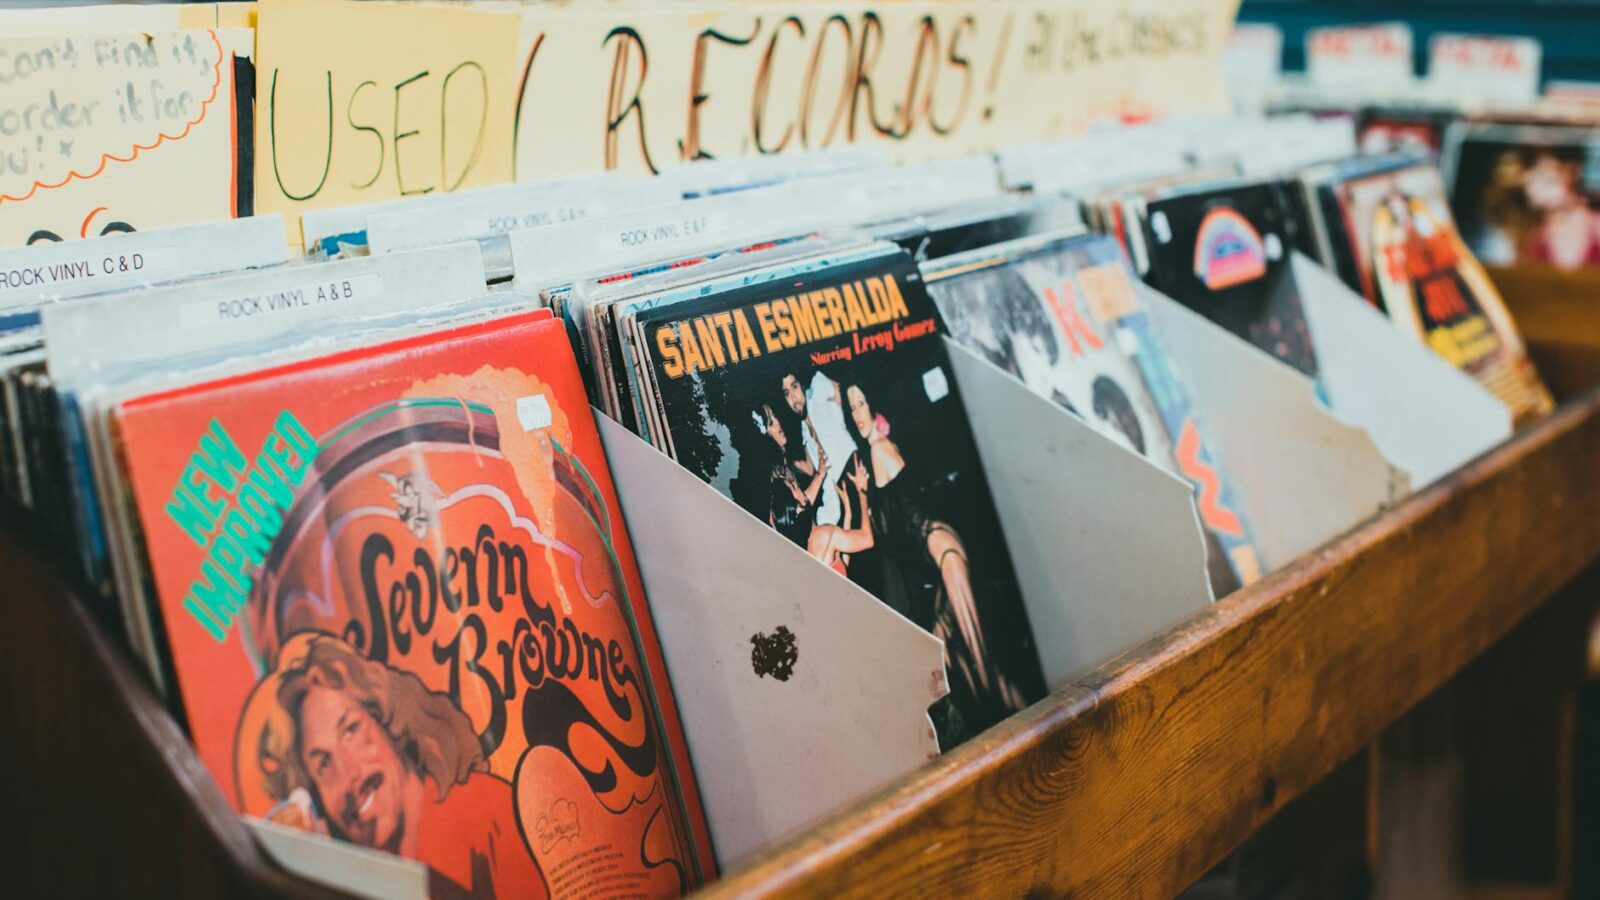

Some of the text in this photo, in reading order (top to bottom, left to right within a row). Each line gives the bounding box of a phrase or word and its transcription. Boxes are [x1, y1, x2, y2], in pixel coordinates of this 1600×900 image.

[0, 89, 99, 136] order
[115, 81, 143, 123] it
[270, 60, 489, 201] USED
[488, 214, 519, 233] ROCK
[523, 211, 552, 228] VINYL
[620, 228, 649, 248] ROCK
[653, 223, 680, 241] VINYL
[0, 253, 144, 289] ROCK VINYL C & D
[218, 281, 353, 320] ROCK VINYL A & B
[656, 308, 762, 380] SANTA
[753, 273, 910, 354] ESMERALDA
[810, 346, 852, 366] Starring
[852, 330, 895, 356] Leroy
[165, 417, 248, 547] NEW
[183, 409, 319, 644] IMPROVED
[344, 523, 556, 664] Severin
[432, 612, 656, 778] Browne
